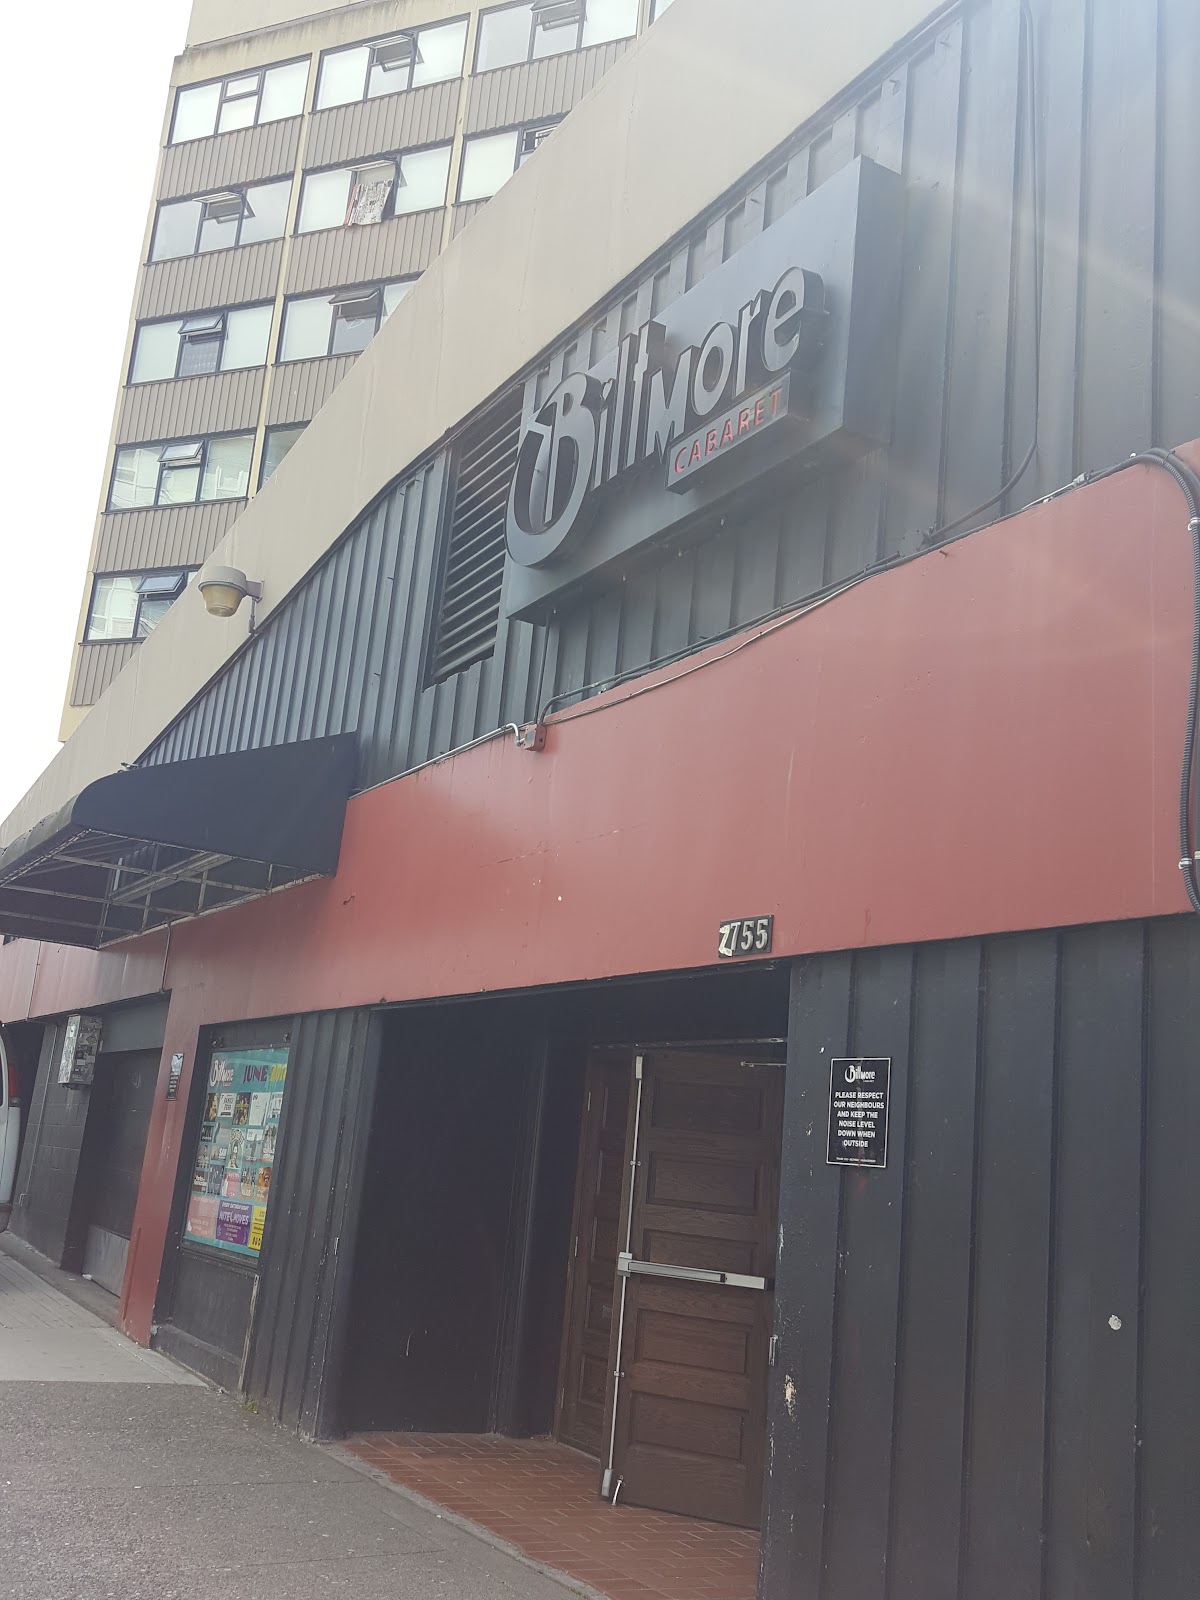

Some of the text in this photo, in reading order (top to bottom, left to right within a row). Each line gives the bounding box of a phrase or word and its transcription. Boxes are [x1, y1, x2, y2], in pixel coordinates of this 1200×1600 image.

[504, 266, 814, 567] Biltmore
[674, 387, 781, 474] CABARET
[718, 919, 769, 957] 2755
[243, 1064, 269, 1084] JUNE
[857, 1092, 884, 1100] RESPECT
[846, 1102, 885, 1110] NEIGHBOURS
[850, 1111, 866, 1119] KEEP
[866, 1111, 879, 1119] THE
[838, 1120, 876, 1129] NOISE LEVEL
[837, 1130, 876, 1138] DOWN WHEN
[843, 1140, 869, 1148] OUTSIDE
